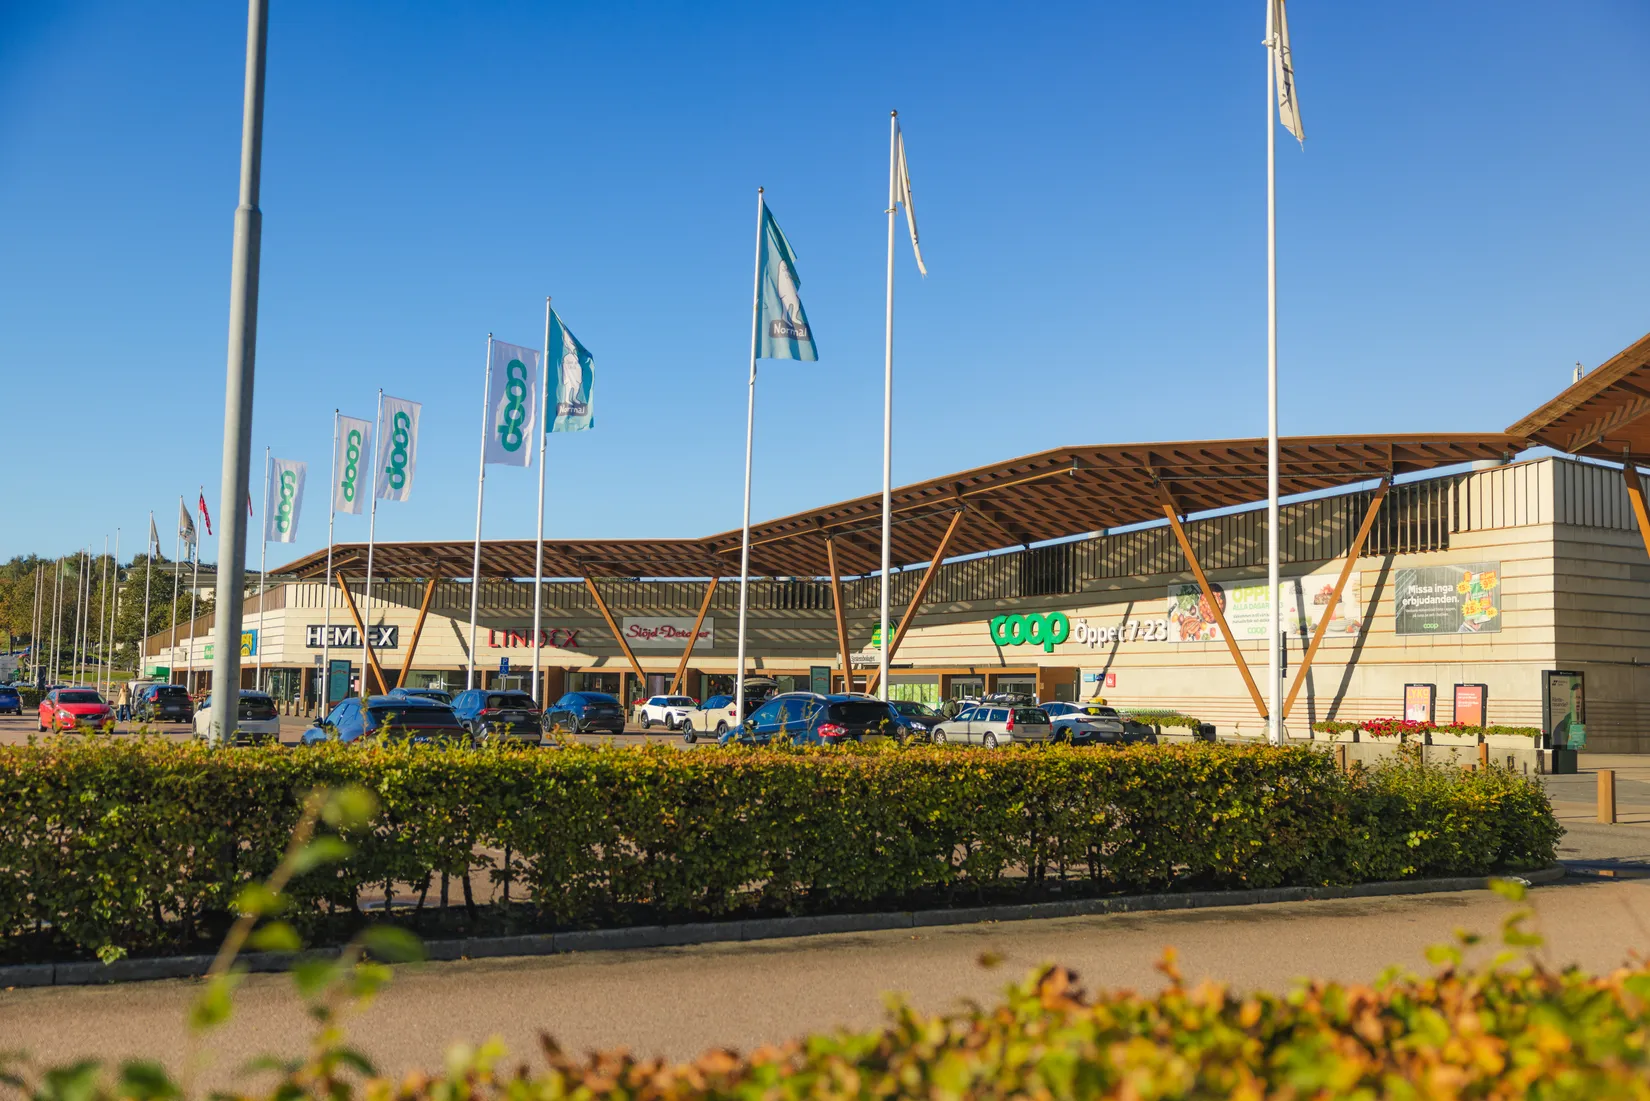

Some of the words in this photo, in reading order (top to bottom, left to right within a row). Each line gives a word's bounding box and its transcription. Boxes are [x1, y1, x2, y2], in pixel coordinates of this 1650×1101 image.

[773, 322, 807, 337] Normal
[497, 358, 528, 452] coop
[559, 405, 585, 414] Normal
[385, 411, 411, 490] coop
[341, 429, 362, 502] coop
[274, 470, 297, 534] coop
[1408, 585, 1433, 595] Missa
[1434, 583, 1453, 594] inga
[1402, 595, 1459, 607] erbjudanden.
[488, 628, 580, 648] LINDEX
[991, 611, 1070, 653] coop
[1075, 618, 1125, 649] Öppet
[1126, 619, 1168, 642] 7-23
[1247, 627, 1267, 635] coop
[1407, 688, 1429, 699] LYKO
